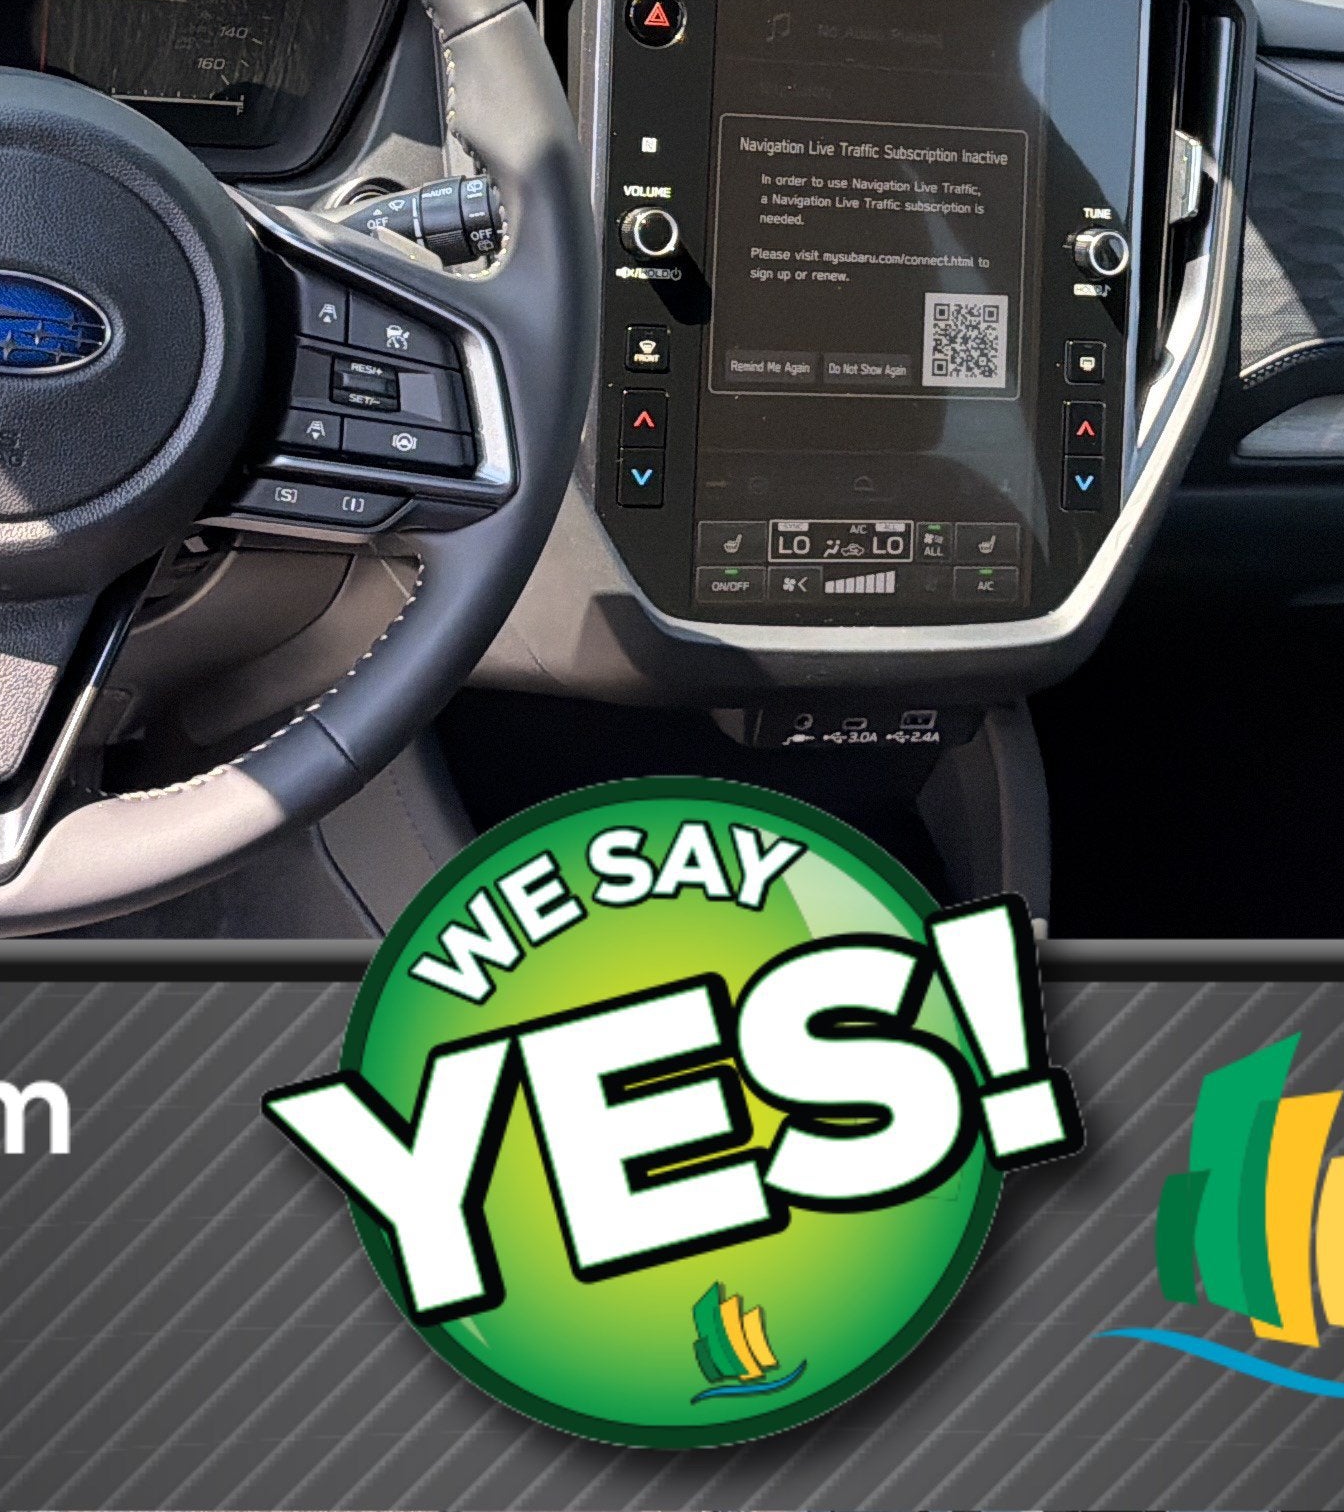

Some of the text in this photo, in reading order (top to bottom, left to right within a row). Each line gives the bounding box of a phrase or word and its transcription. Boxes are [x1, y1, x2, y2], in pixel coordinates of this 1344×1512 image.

[219, 26, 249, 39] 140
[197, 57, 226, 70] 160
[740, 137, 1008, 166] Navigation Live Traffic Subscription Inactive
[761, 173, 981, 197] In order to use Navigation Live Traffic,
[431, 187, 453, 198] AUTO
[623, 185, 672, 199] VOLUME
[772, 193, 831, 210] Navigation
[835, 196, 859, 209] Live
[863, 197, 900, 211] Traffic
[905, 199, 971, 216] subscription
[974, 203, 985, 215] is
[759, 212, 805, 226] needed.
[1083, 207, 1112, 220] TUNE
[470, 228, 493, 241] OFF
[750, 247, 990, 269] Please visit mysubaru.com/connect.html to
[750, 267, 850, 283] sign up or renew.
[730, 360, 811, 377] Remind Me Again
[828, 363, 907, 378] Do Not Show Again
[850, 524, 869, 535] A/C
[778, 536, 811, 555] LO
[872, 536, 904, 555] LO
[923, 546, 944, 557] ALL
[711, 581, 750, 593] ON/OFF
[976, 580, 995, 592] A/C
[848, 731, 878, 744] 3.0A
[910, 731, 940, 744] 2.4A
